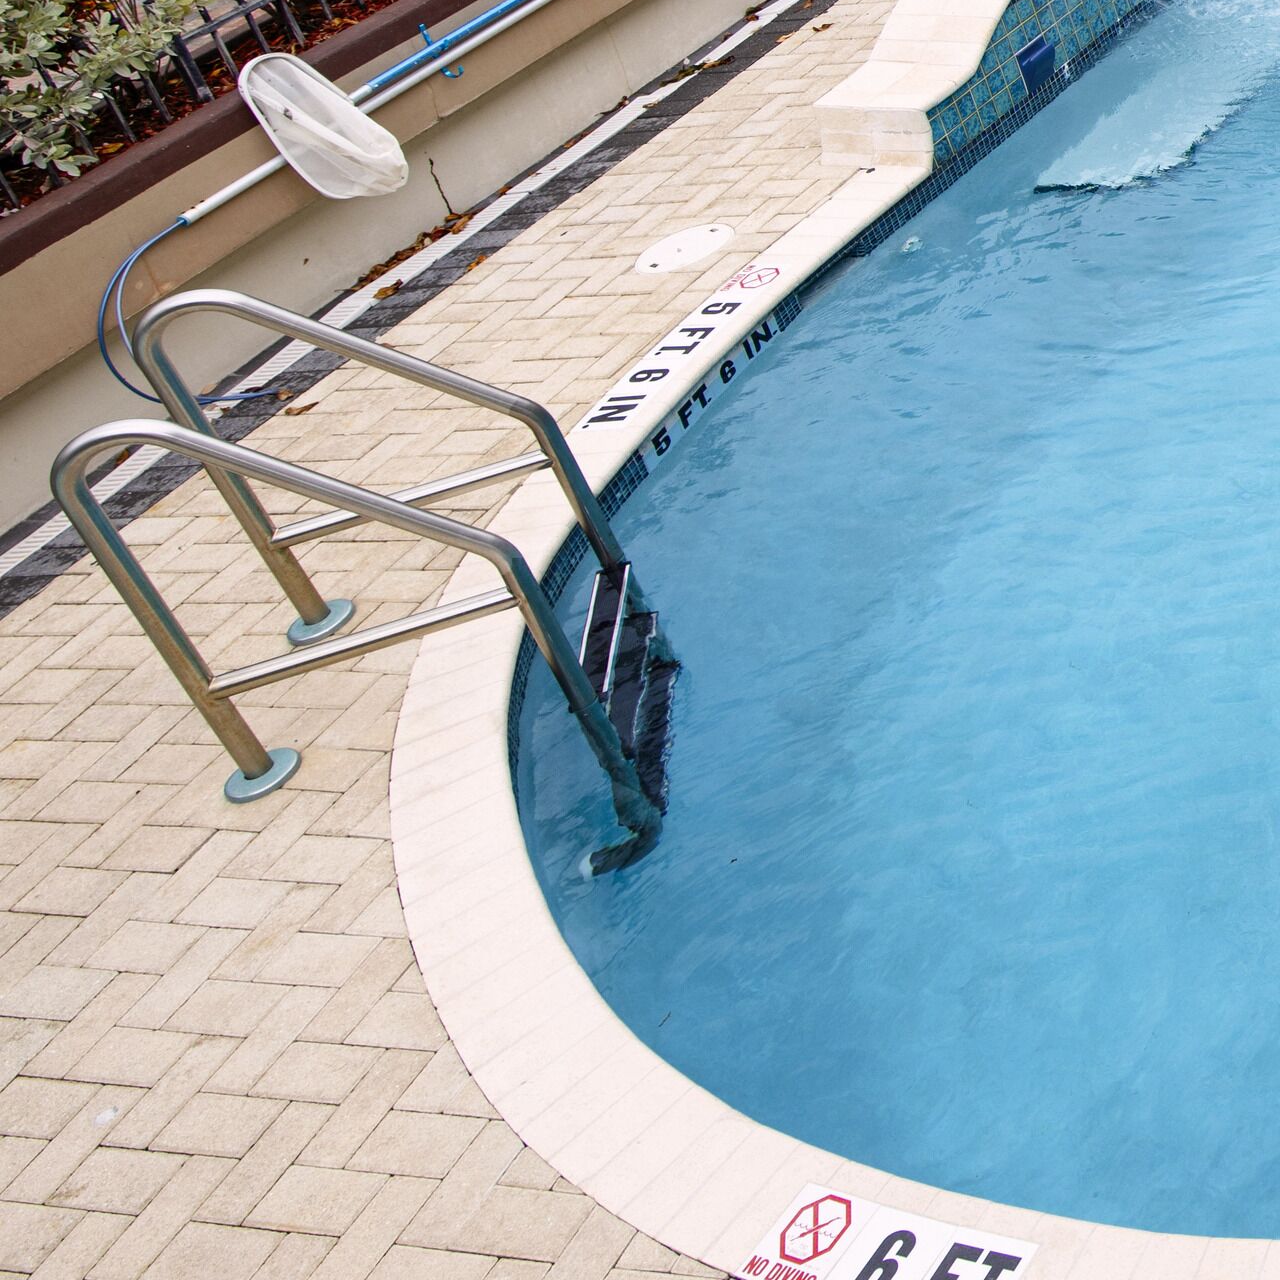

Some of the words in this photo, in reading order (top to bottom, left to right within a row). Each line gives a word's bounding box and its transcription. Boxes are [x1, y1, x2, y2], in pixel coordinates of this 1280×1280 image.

[701, 302, 743, 315] 5
[654, 327, 716, 356] FT.
[629, 368, 670, 383] 6
[651, 426, 672, 456] 5
[677, 384, 712, 429] FT.
[720, 360, 737, 384] 6
[743, 320, 778, 360] IN.
[582, 394, 647, 429] IN.
[742, 1255, 769, 1277] NO
[855, 1230, 917, 1280] 6
